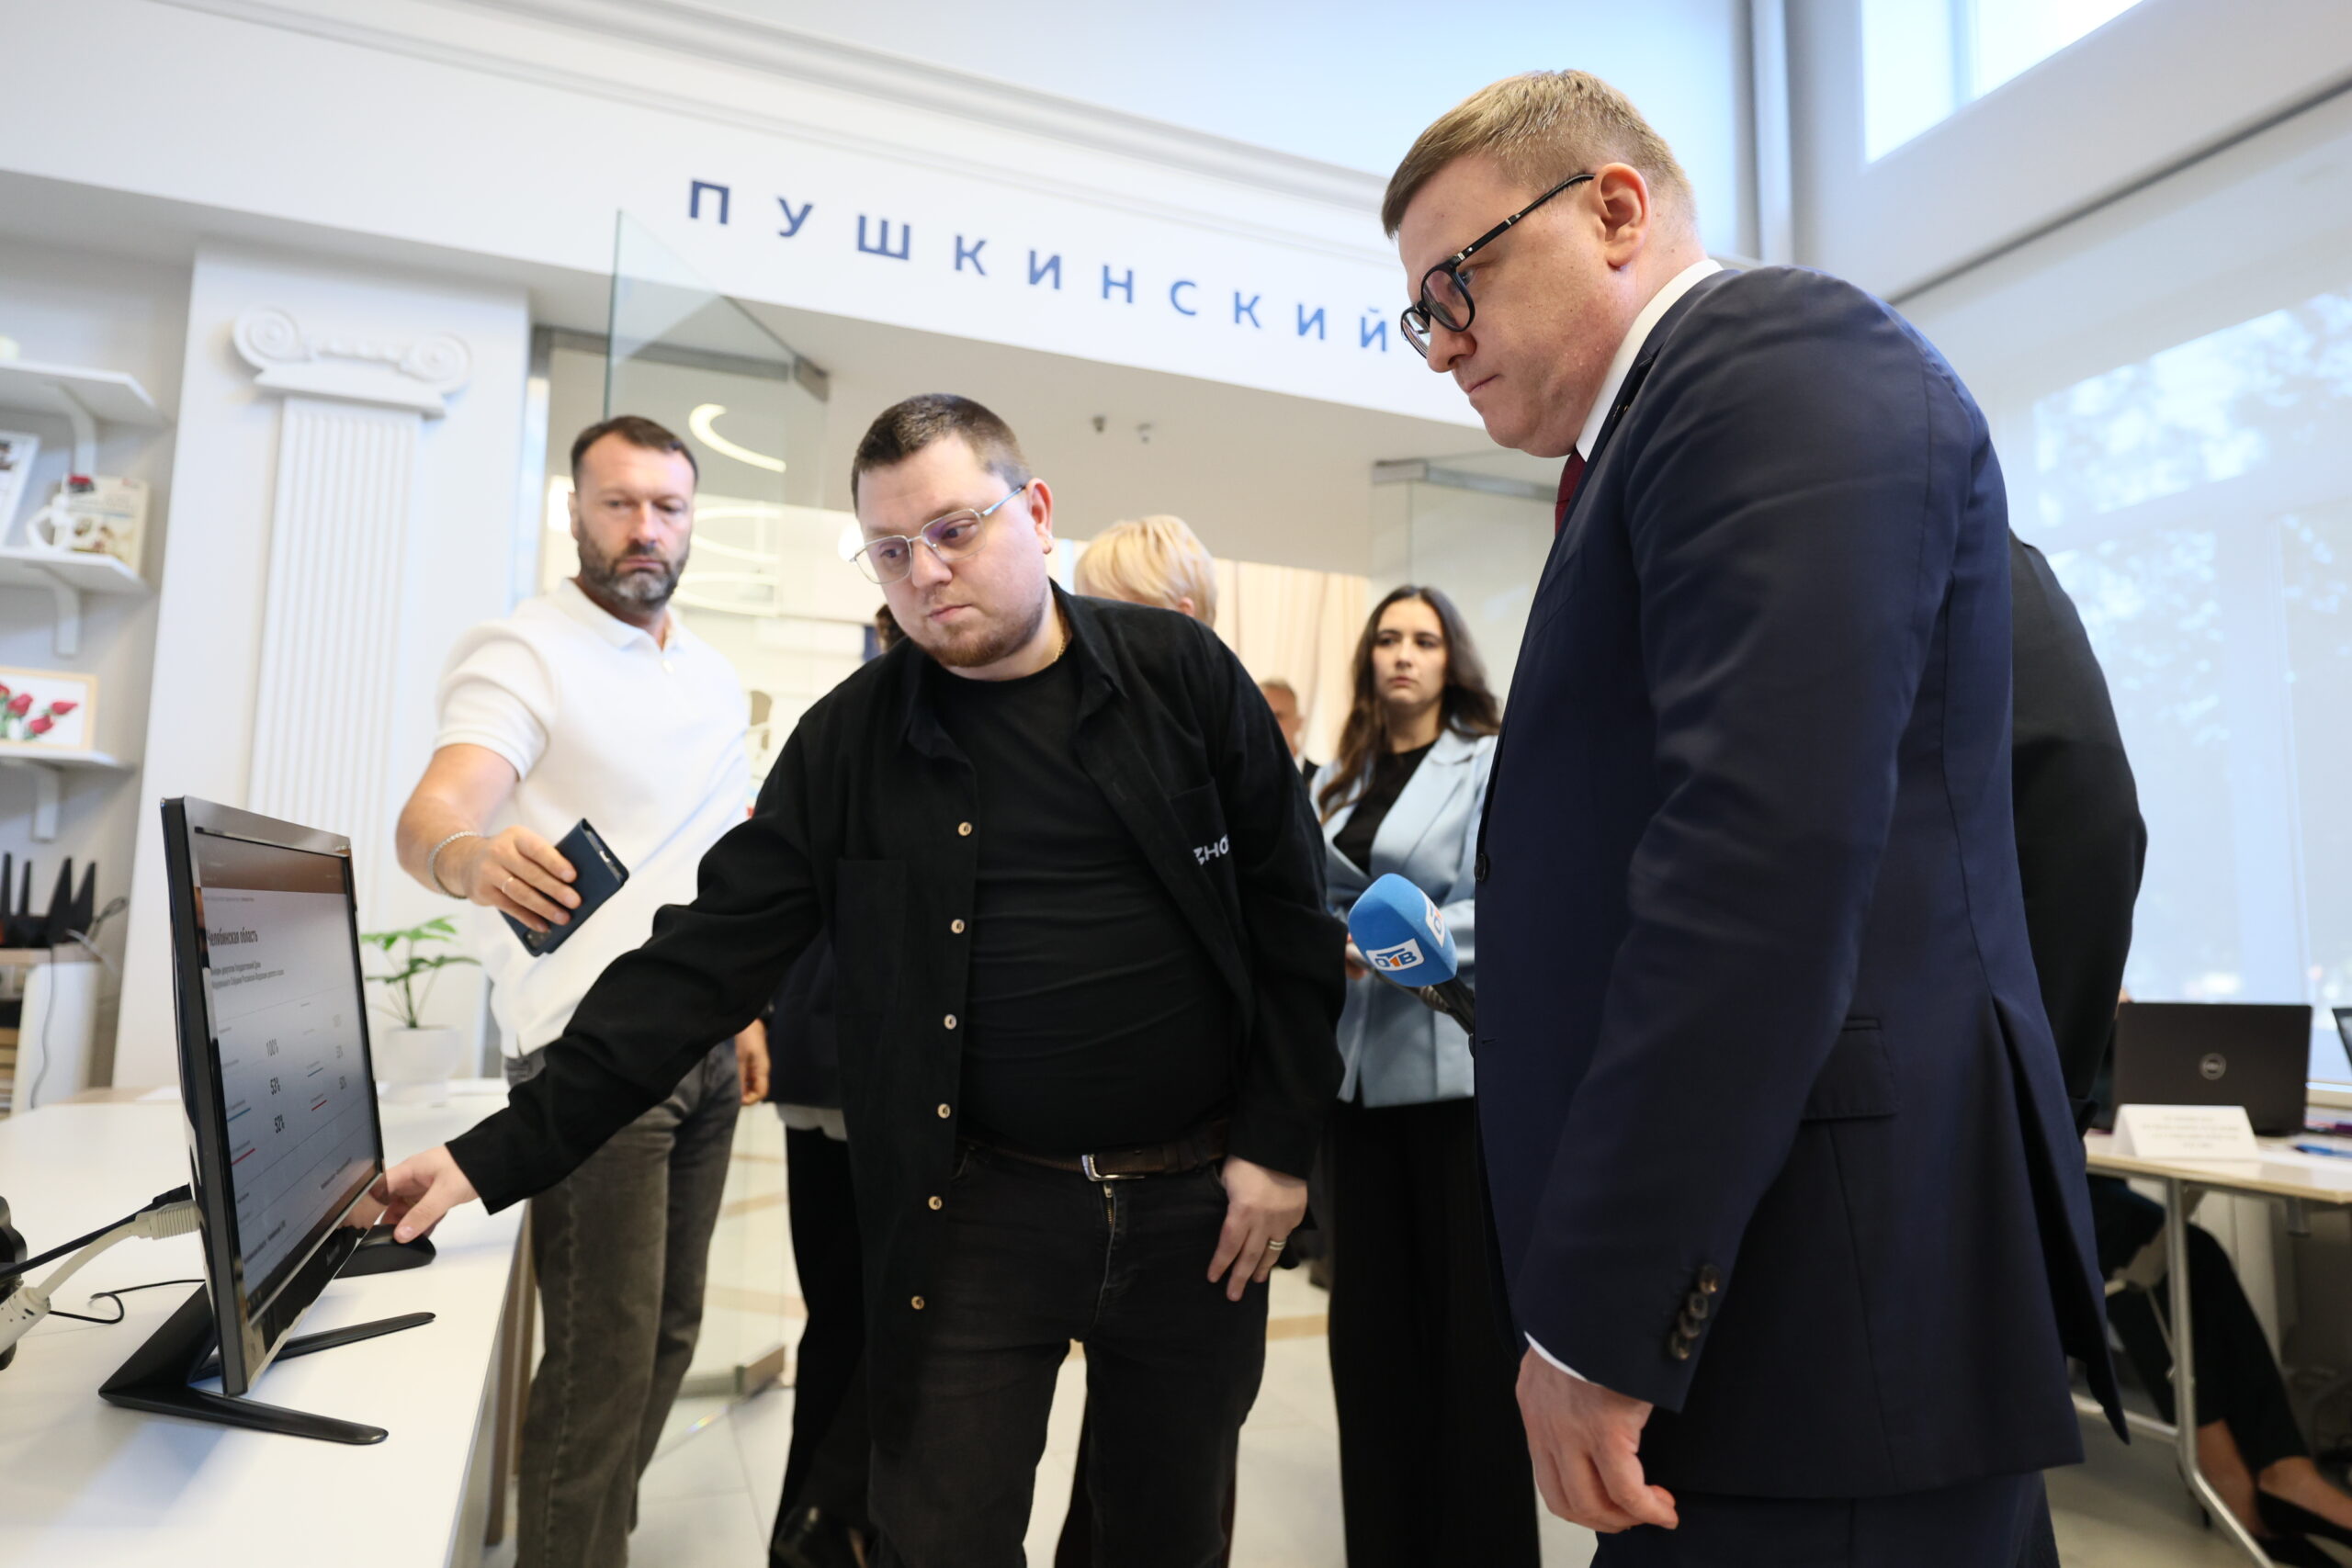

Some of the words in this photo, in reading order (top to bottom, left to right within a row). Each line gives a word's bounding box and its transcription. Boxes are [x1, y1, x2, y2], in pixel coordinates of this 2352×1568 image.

[690, 179, 1387, 353] ПУШКИНСКИЙ
[240, 926, 258, 944] область
[1374, 947, 1418, 968] ОТВ
